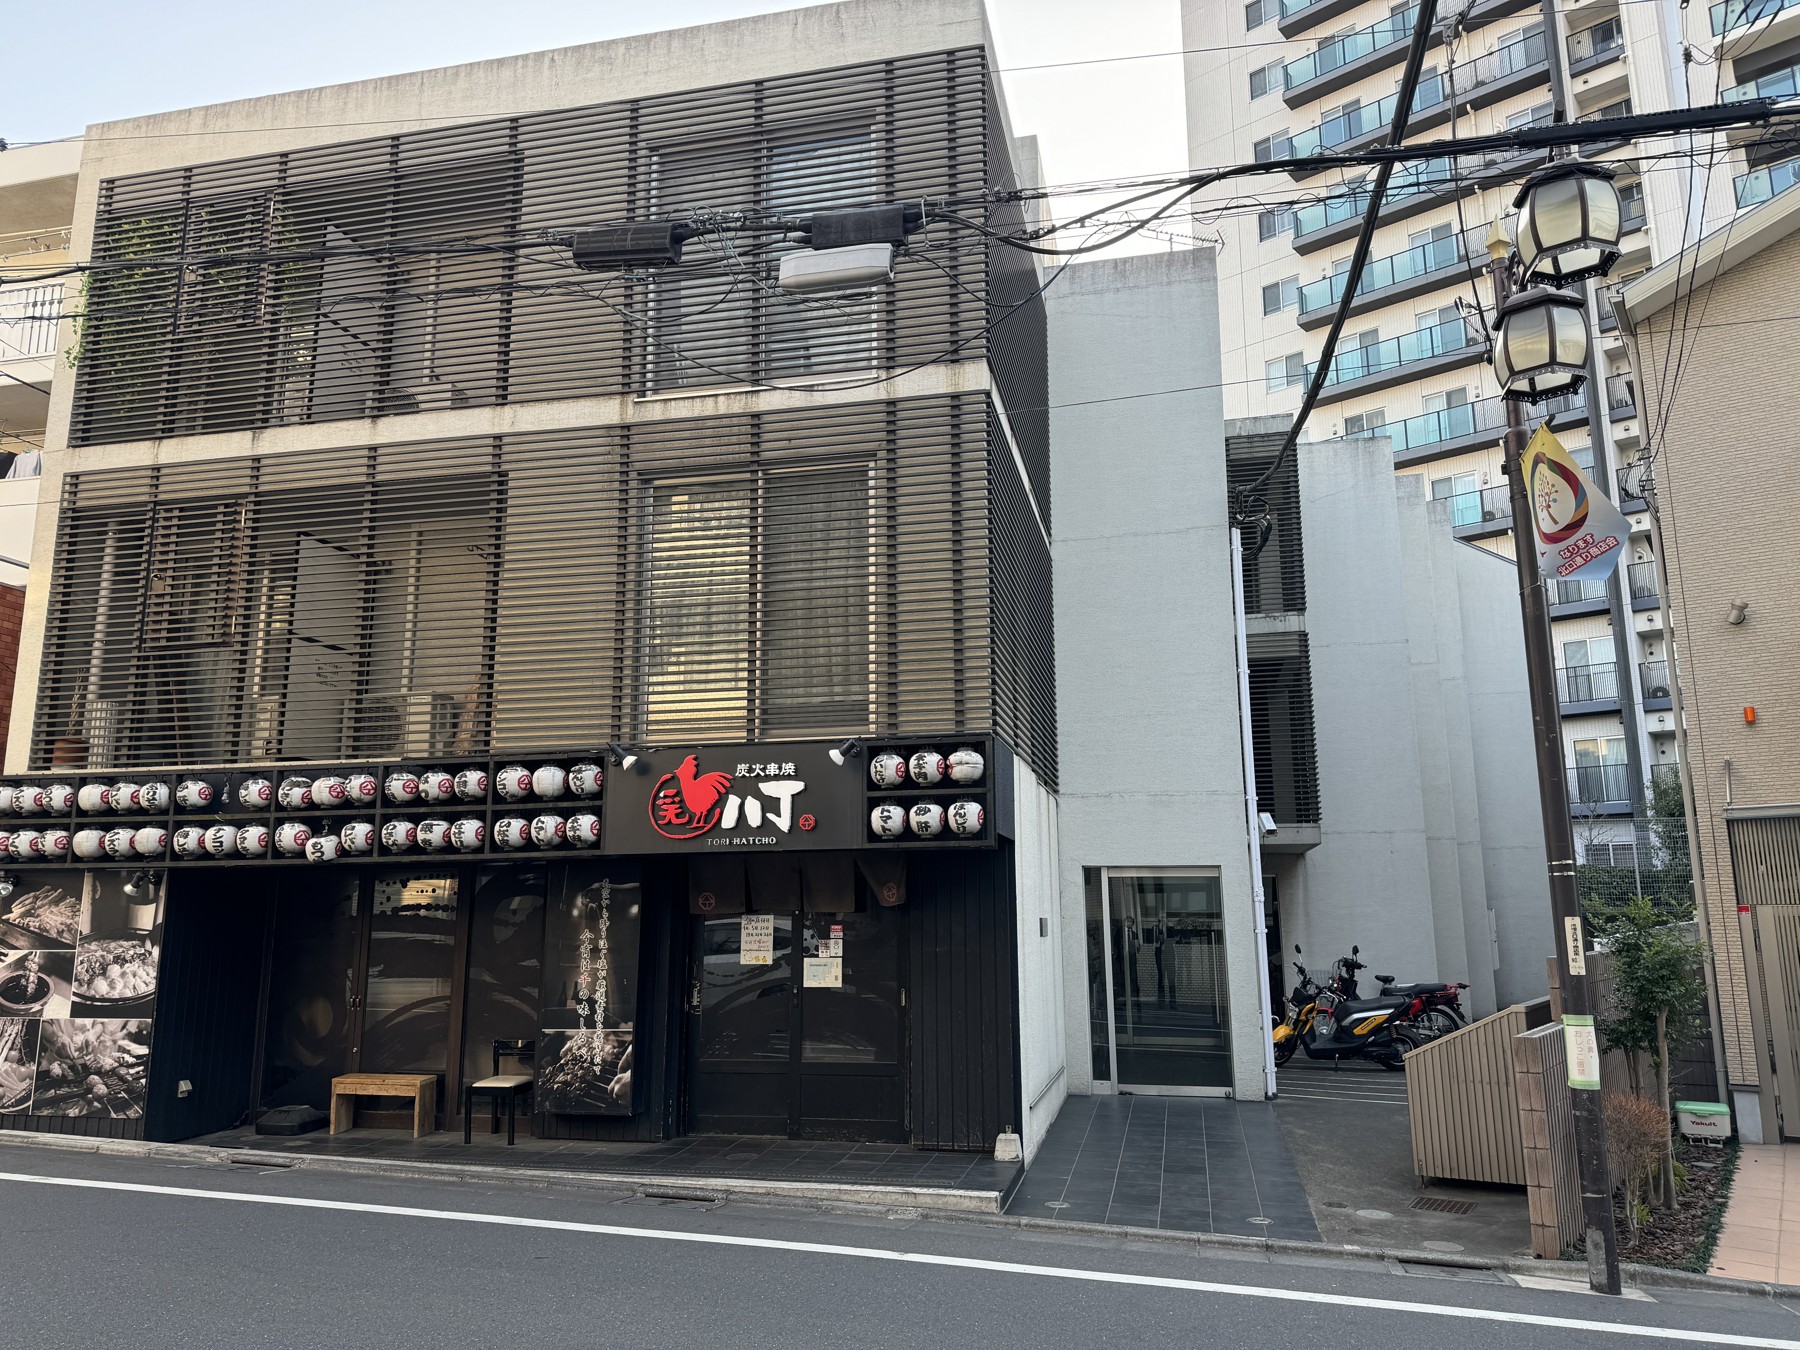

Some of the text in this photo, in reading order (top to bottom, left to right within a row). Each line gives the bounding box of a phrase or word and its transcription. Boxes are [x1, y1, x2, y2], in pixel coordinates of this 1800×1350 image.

[1558, 537, 1618, 576] 北口通り商店会
[1560, 534, 1594, 558] なります
[735, 762, 797, 777] 炭火串焼
[721, 780, 806, 834] 八丁
[915, 806, 931, 832] 砂肝
[533, 818, 545, 843] トマト
[880, 807, 892, 833] トマト
[107, 831, 119, 855] ウズラ
